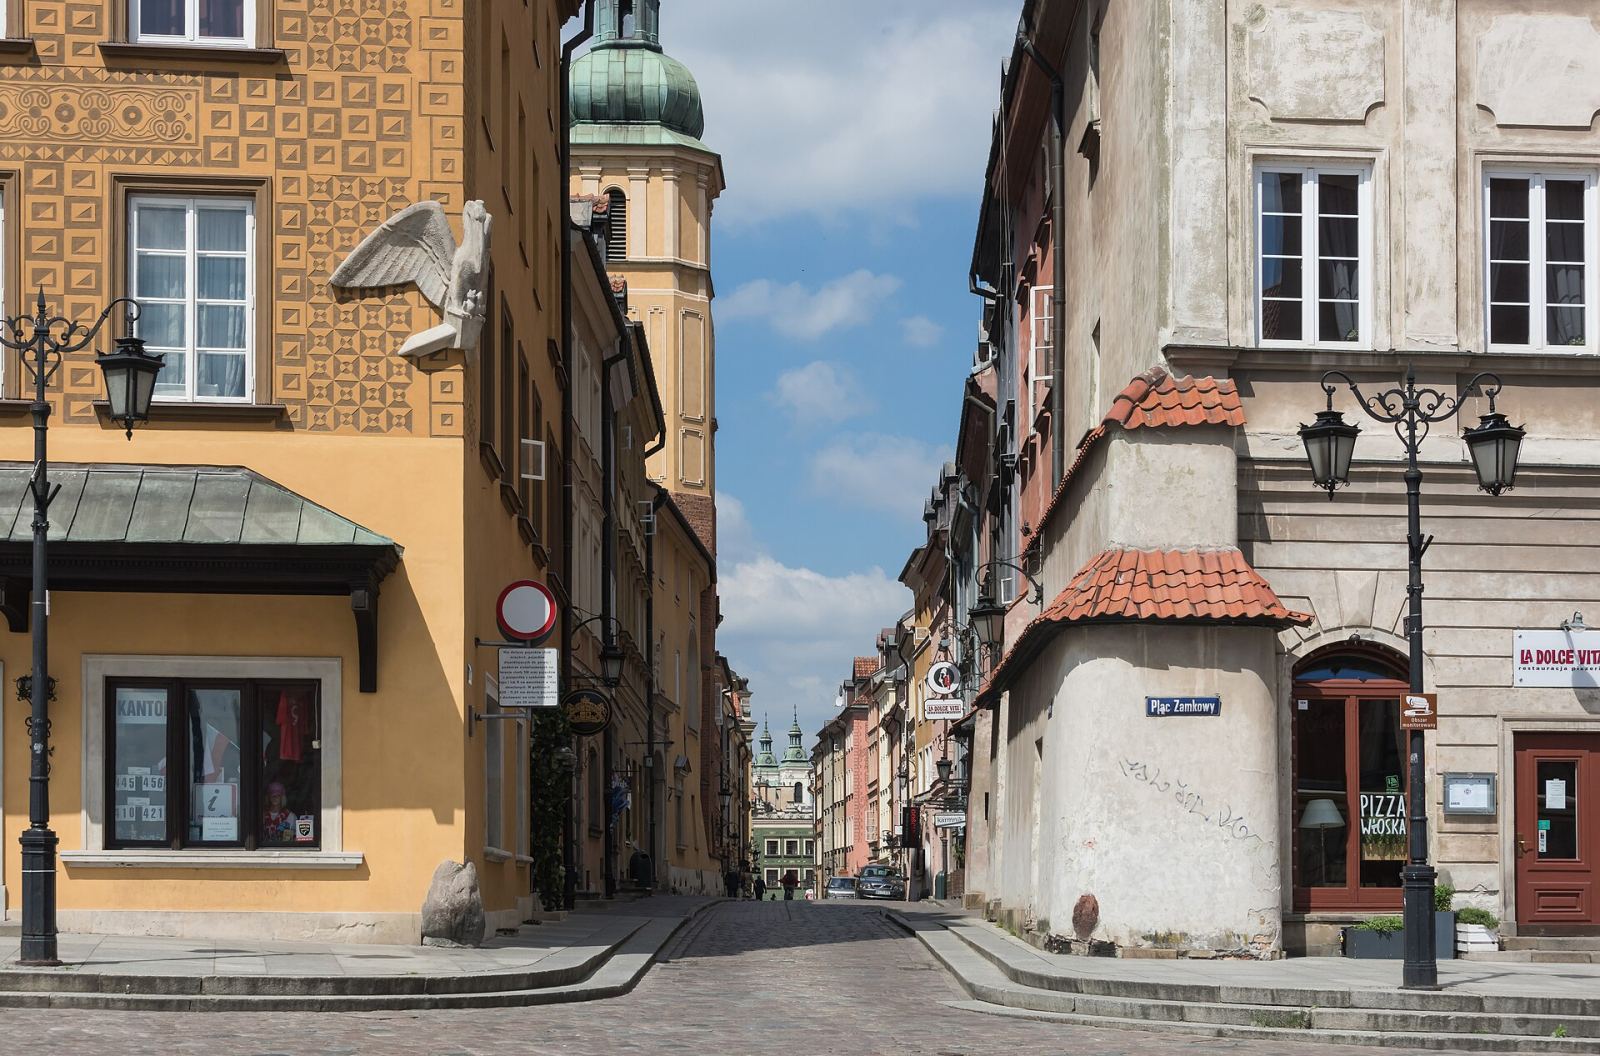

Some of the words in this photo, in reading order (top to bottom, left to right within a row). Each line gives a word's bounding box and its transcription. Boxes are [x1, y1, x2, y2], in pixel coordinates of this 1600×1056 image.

[1520, 649, 1534, 665] LA
[1536, 649, 1574, 665] DOLCE
[1577, 649, 1600, 665] VIT
[1151, 699, 1171, 714] Plac
[1173, 699, 1215, 715] Zamkowy
[143, 777, 163, 789] 456
[143, 807, 162, 819] 421
[1360, 794, 1406, 818] PIZZA
[1360, 818, 1407, 835] WŁOSKA
